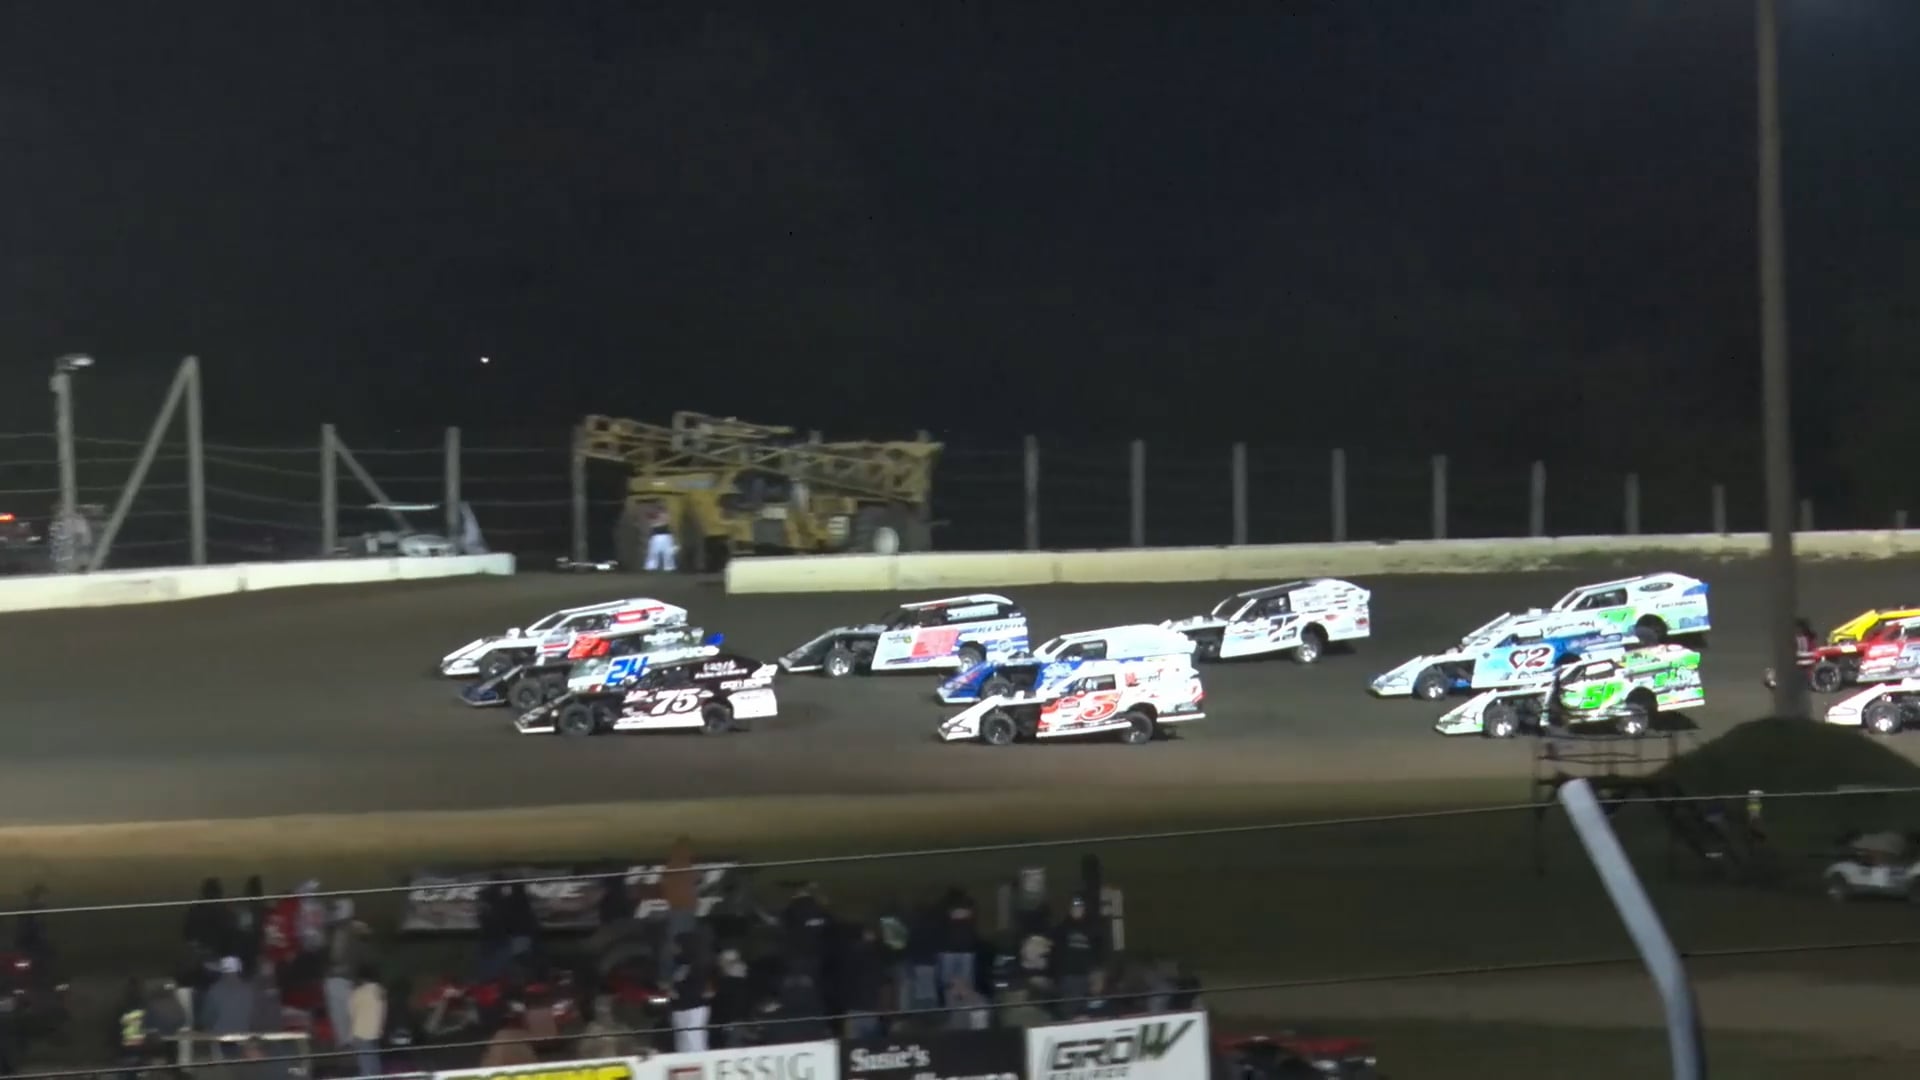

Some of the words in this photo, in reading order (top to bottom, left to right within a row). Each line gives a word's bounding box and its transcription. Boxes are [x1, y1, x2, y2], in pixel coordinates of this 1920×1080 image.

[604, 656, 649, 686] 24
[650, 687, 702, 717] 75
[713, 1051, 816, 1080] ESSIG
